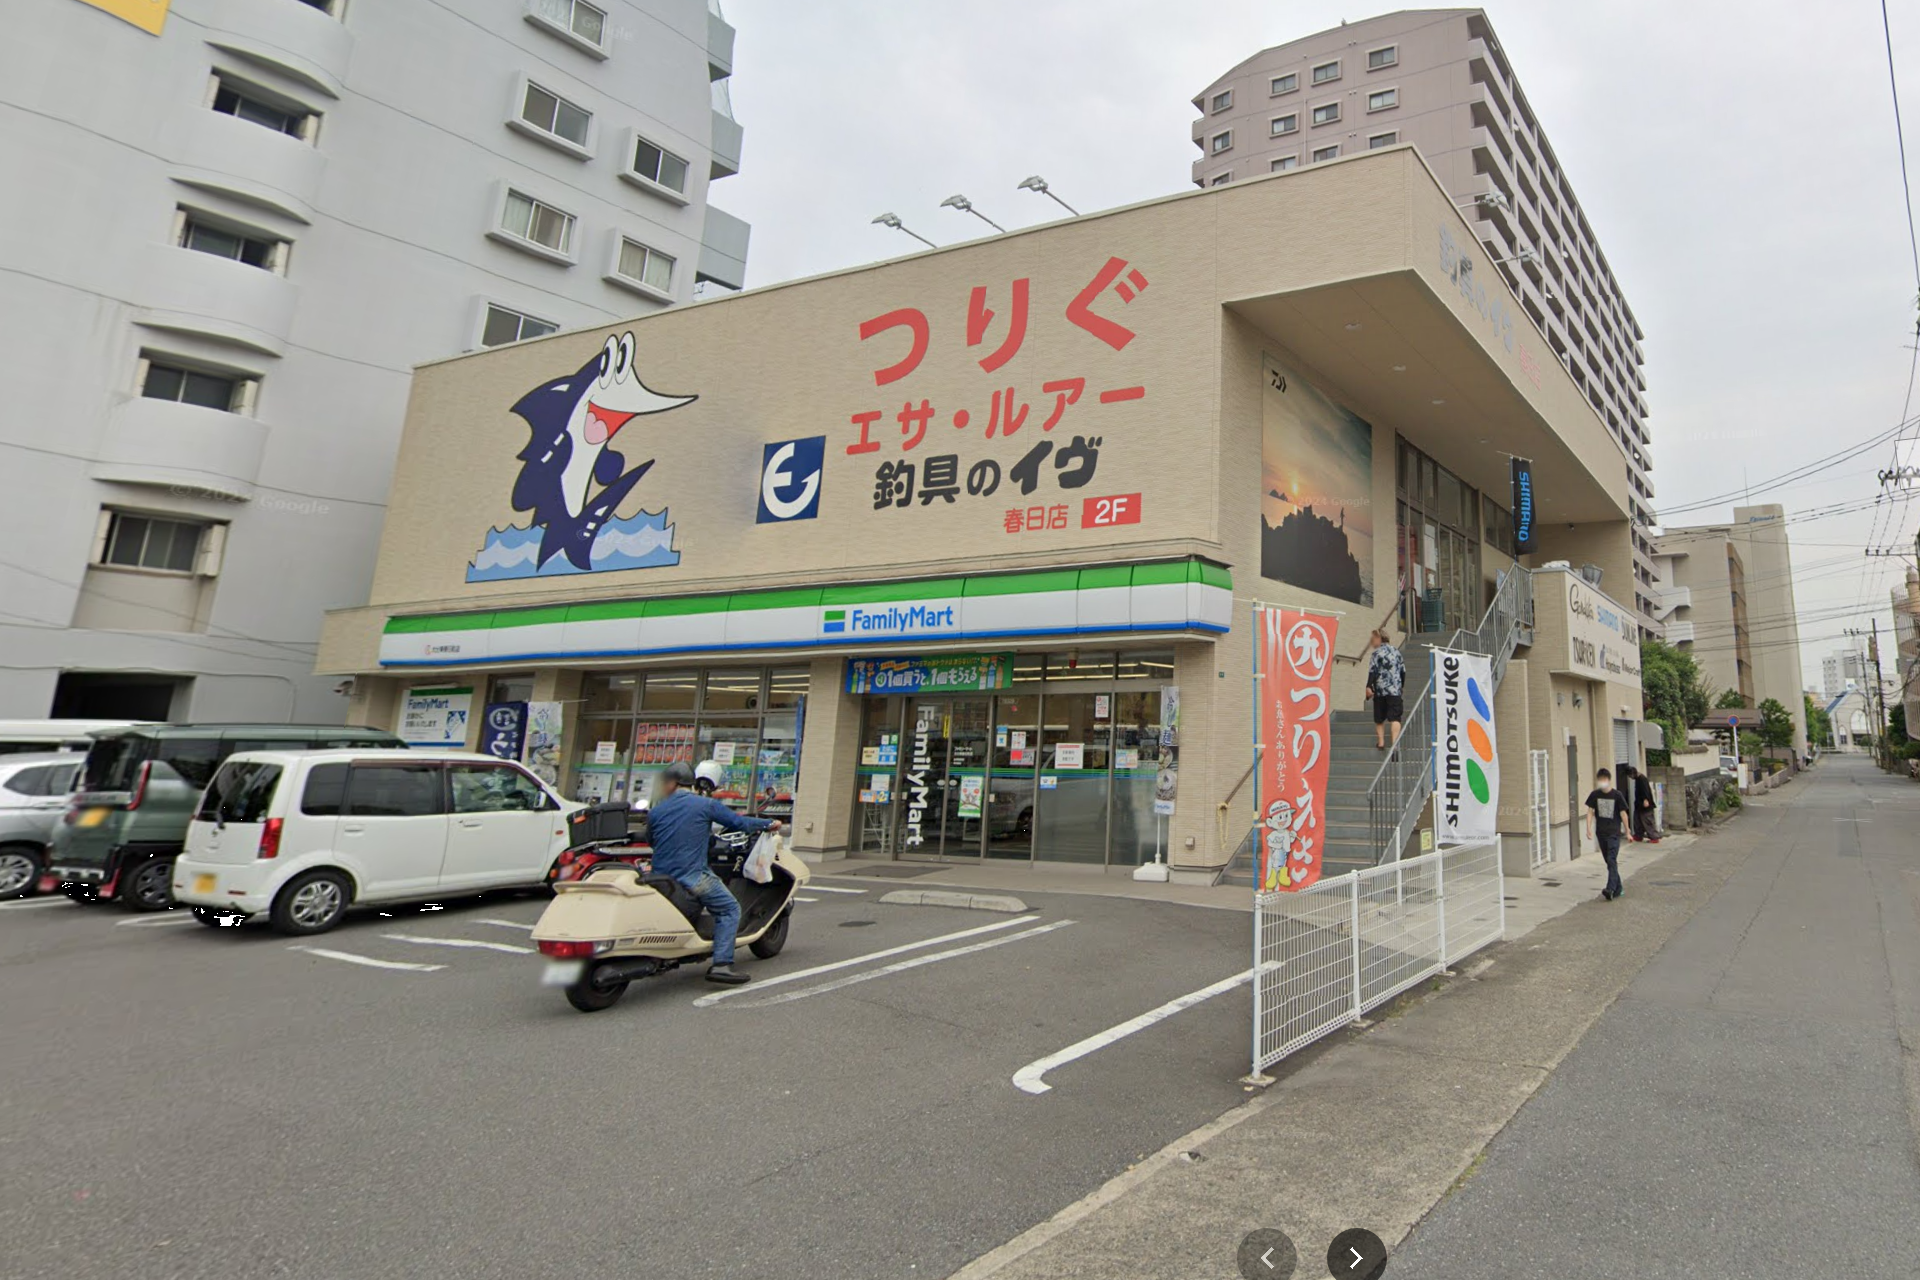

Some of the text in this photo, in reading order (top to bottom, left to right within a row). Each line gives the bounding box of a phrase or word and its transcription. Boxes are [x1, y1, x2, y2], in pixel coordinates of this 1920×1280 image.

[859, 256, 1149, 386] つりぐ
[846, 377, 1146, 456] エサ・ルアー
[873, 435, 1103, 511] 釣具のイヴ
[1519, 471, 1531, 542] SHIMANO
[1003, 498, 1128, 534] 春日店 2F
[851, 605, 954, 632] FamilyMart
[407, 698, 449, 713] FamilyMart
[907, 706, 935, 845] FamilyMart
